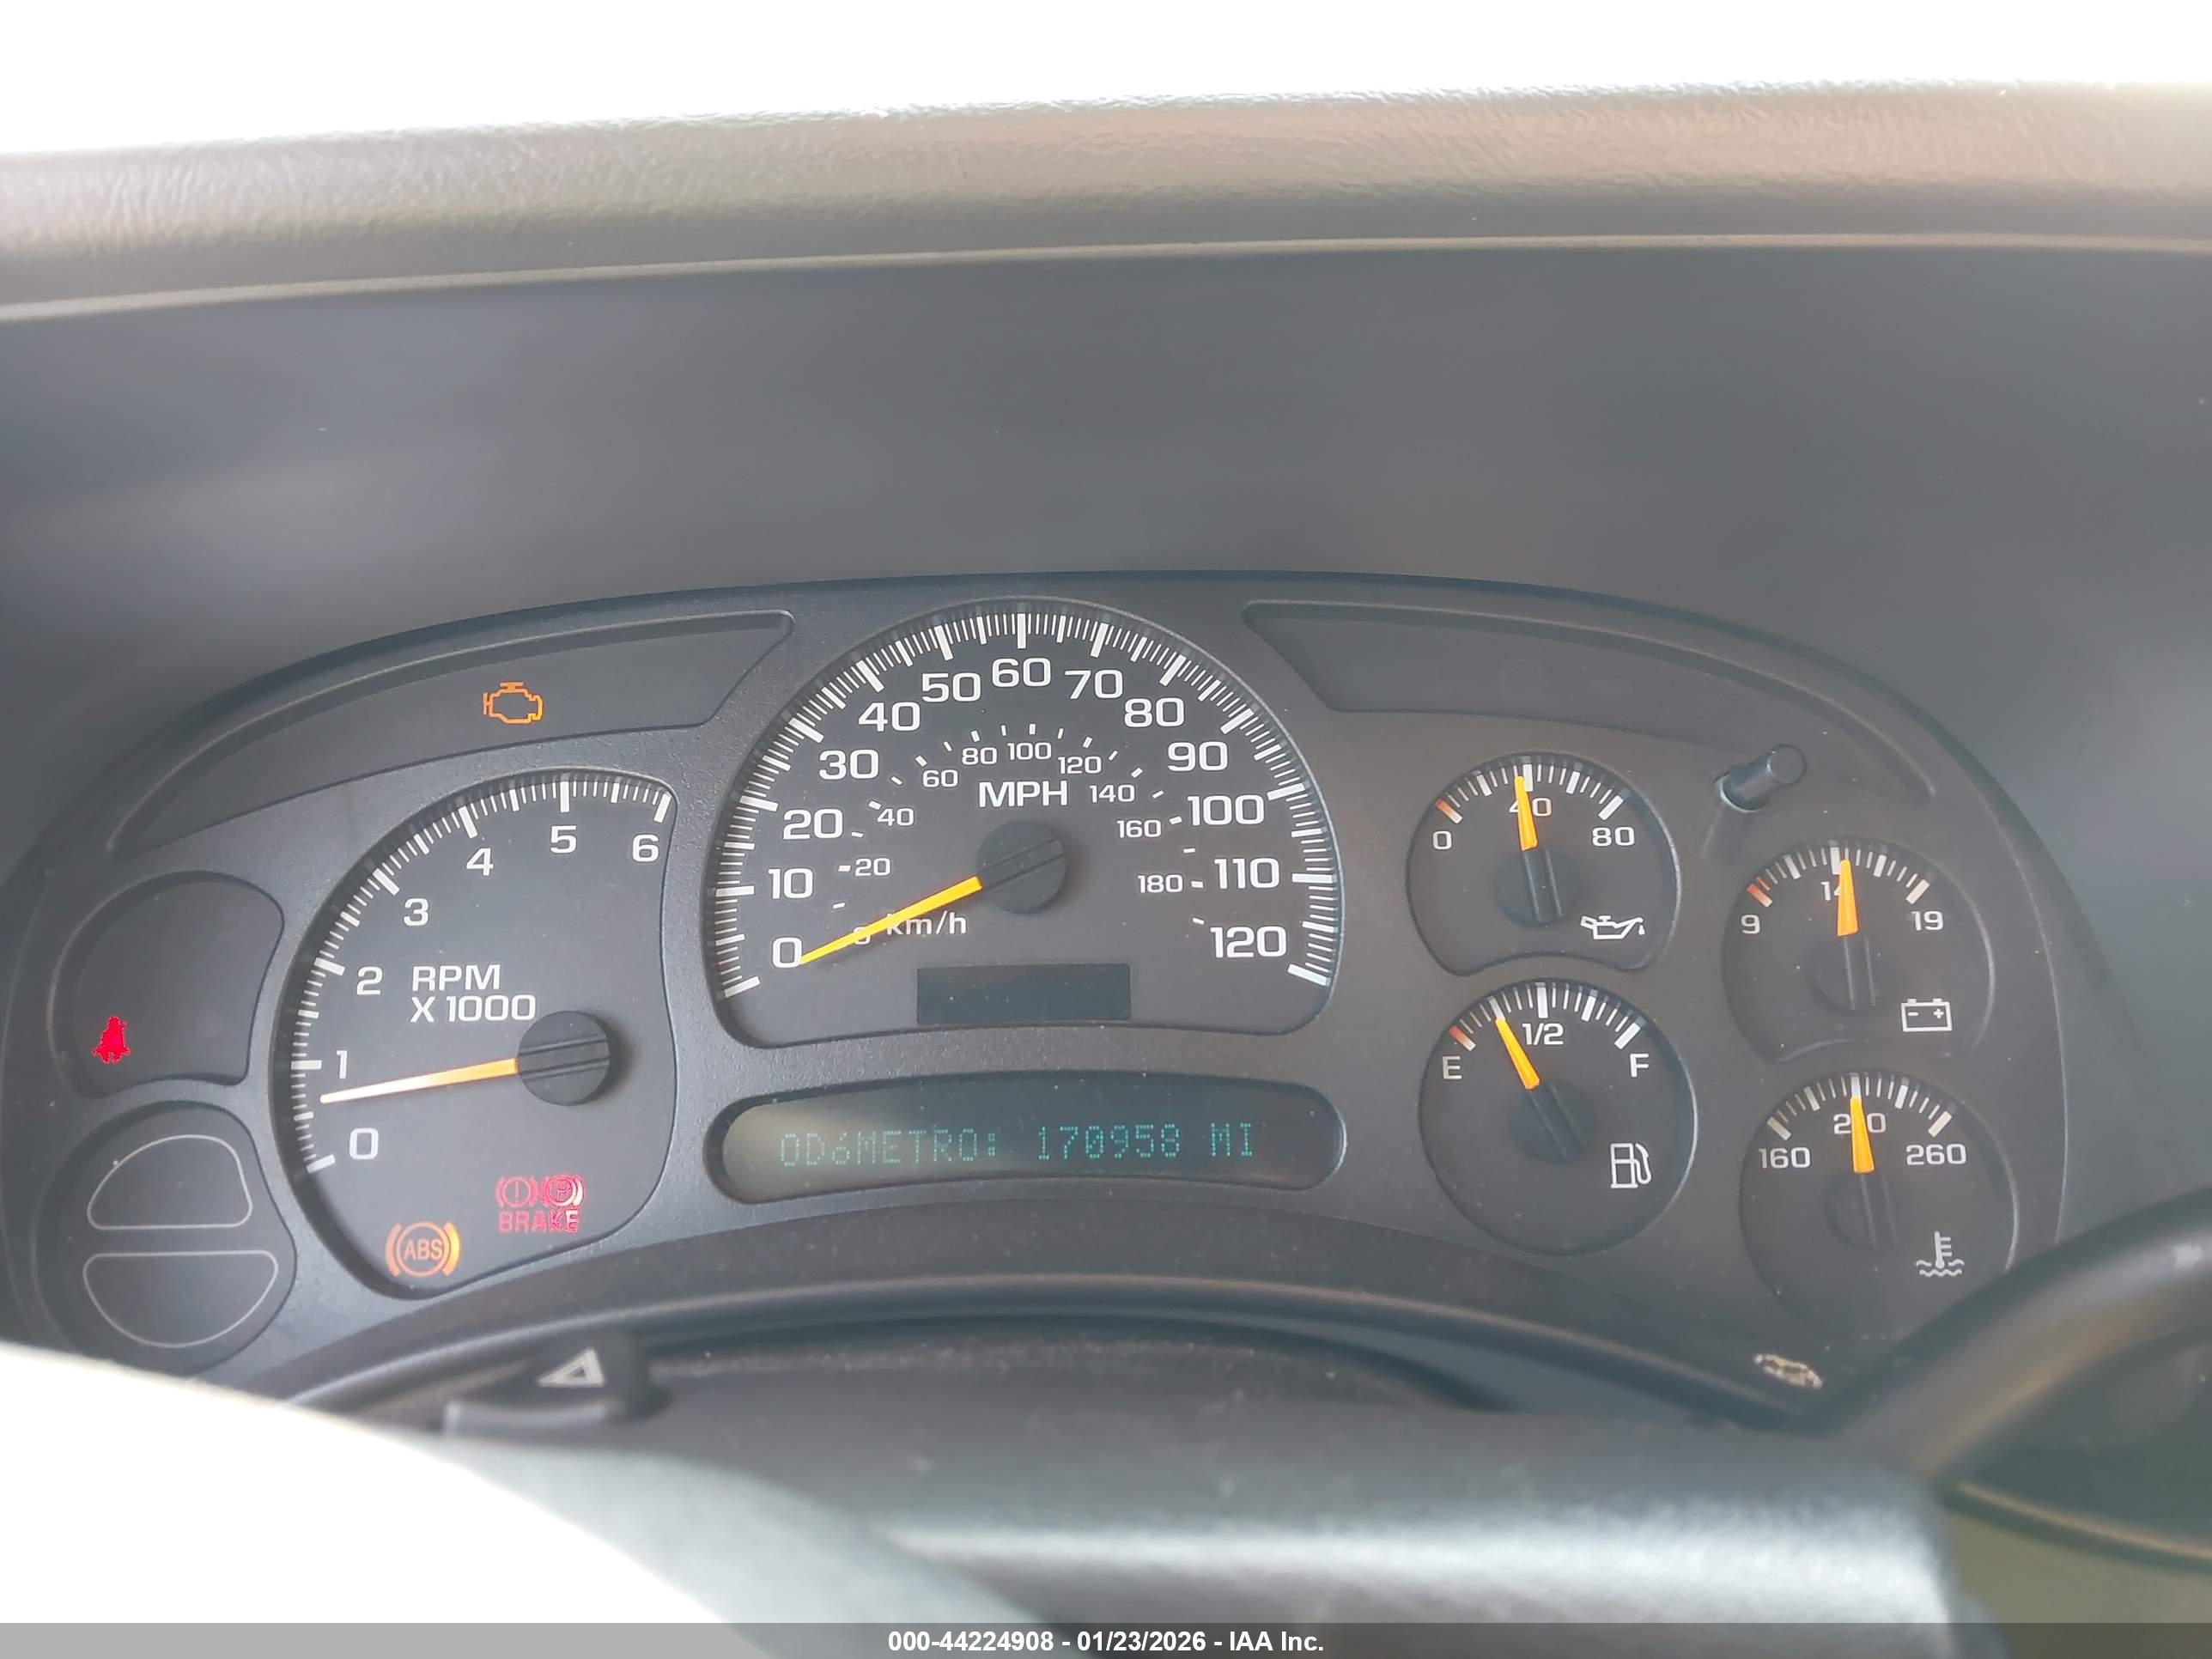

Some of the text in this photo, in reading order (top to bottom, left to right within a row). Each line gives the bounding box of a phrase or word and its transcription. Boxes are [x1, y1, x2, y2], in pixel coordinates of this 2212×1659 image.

[921, 672, 981, 702] 50
[992, 658, 1051, 688] 60
[1064, 669, 1123, 700] 70
[858, 702, 921, 732] 40
[1124, 697, 1184, 727] 80
[819, 749, 879, 780] 30
[962, 747, 998, 765] 80
[1007, 742, 1052, 761] 100
[1057, 756, 1102, 775] 120
[1168, 741, 1228, 772] 90
[922, 769, 958, 787] 60
[979, 780, 1067, 808] MPH
[1089, 784, 1135, 803] 140
[782, 808, 843, 840] 20
[875, 805, 915, 826] 40
[1187, 794, 1265, 826] 100
[550, 825, 577, 854] 5
[1116, 819, 1162, 839] 160
[1432, 830, 1452, 850] 0
[1592, 826, 1635, 847] 80
[466, 848, 494, 876] 4
[632, 834, 659, 862] 6
[854, 857, 890, 877] 20
[1214, 857, 1279, 890] 110
[768, 868, 813, 899] 10
[1137, 874, 1183, 894] 180
[404, 897, 428, 927] 3
[1741, 914, 1760, 934] 9
[1911, 910, 1944, 931] 19
[772, 937, 802, 969] 0
[1210, 926, 1287, 958] 120
[356, 966, 383, 995] 2
[412, 963, 501, 992] RPM
[410, 994, 536, 1023] X 1000
[1522, 1023, 1564, 1046] 1/2
[336, 1049, 348, 1079] 1
[1442, 1055, 1462, 1079] E
[1629, 1053, 1650, 1078] F
[349, 1127, 380, 1160] 0
[1036, 1123, 1182, 1161] 170958
[1209, 1122, 1255, 1158] MI
[1905, 1143, 1966, 1165] 260
[1758, 1146, 1811, 1169] 160
[498, 1208, 579, 1233] BRAKE
[403, 1238, 443, 1261] ABS
